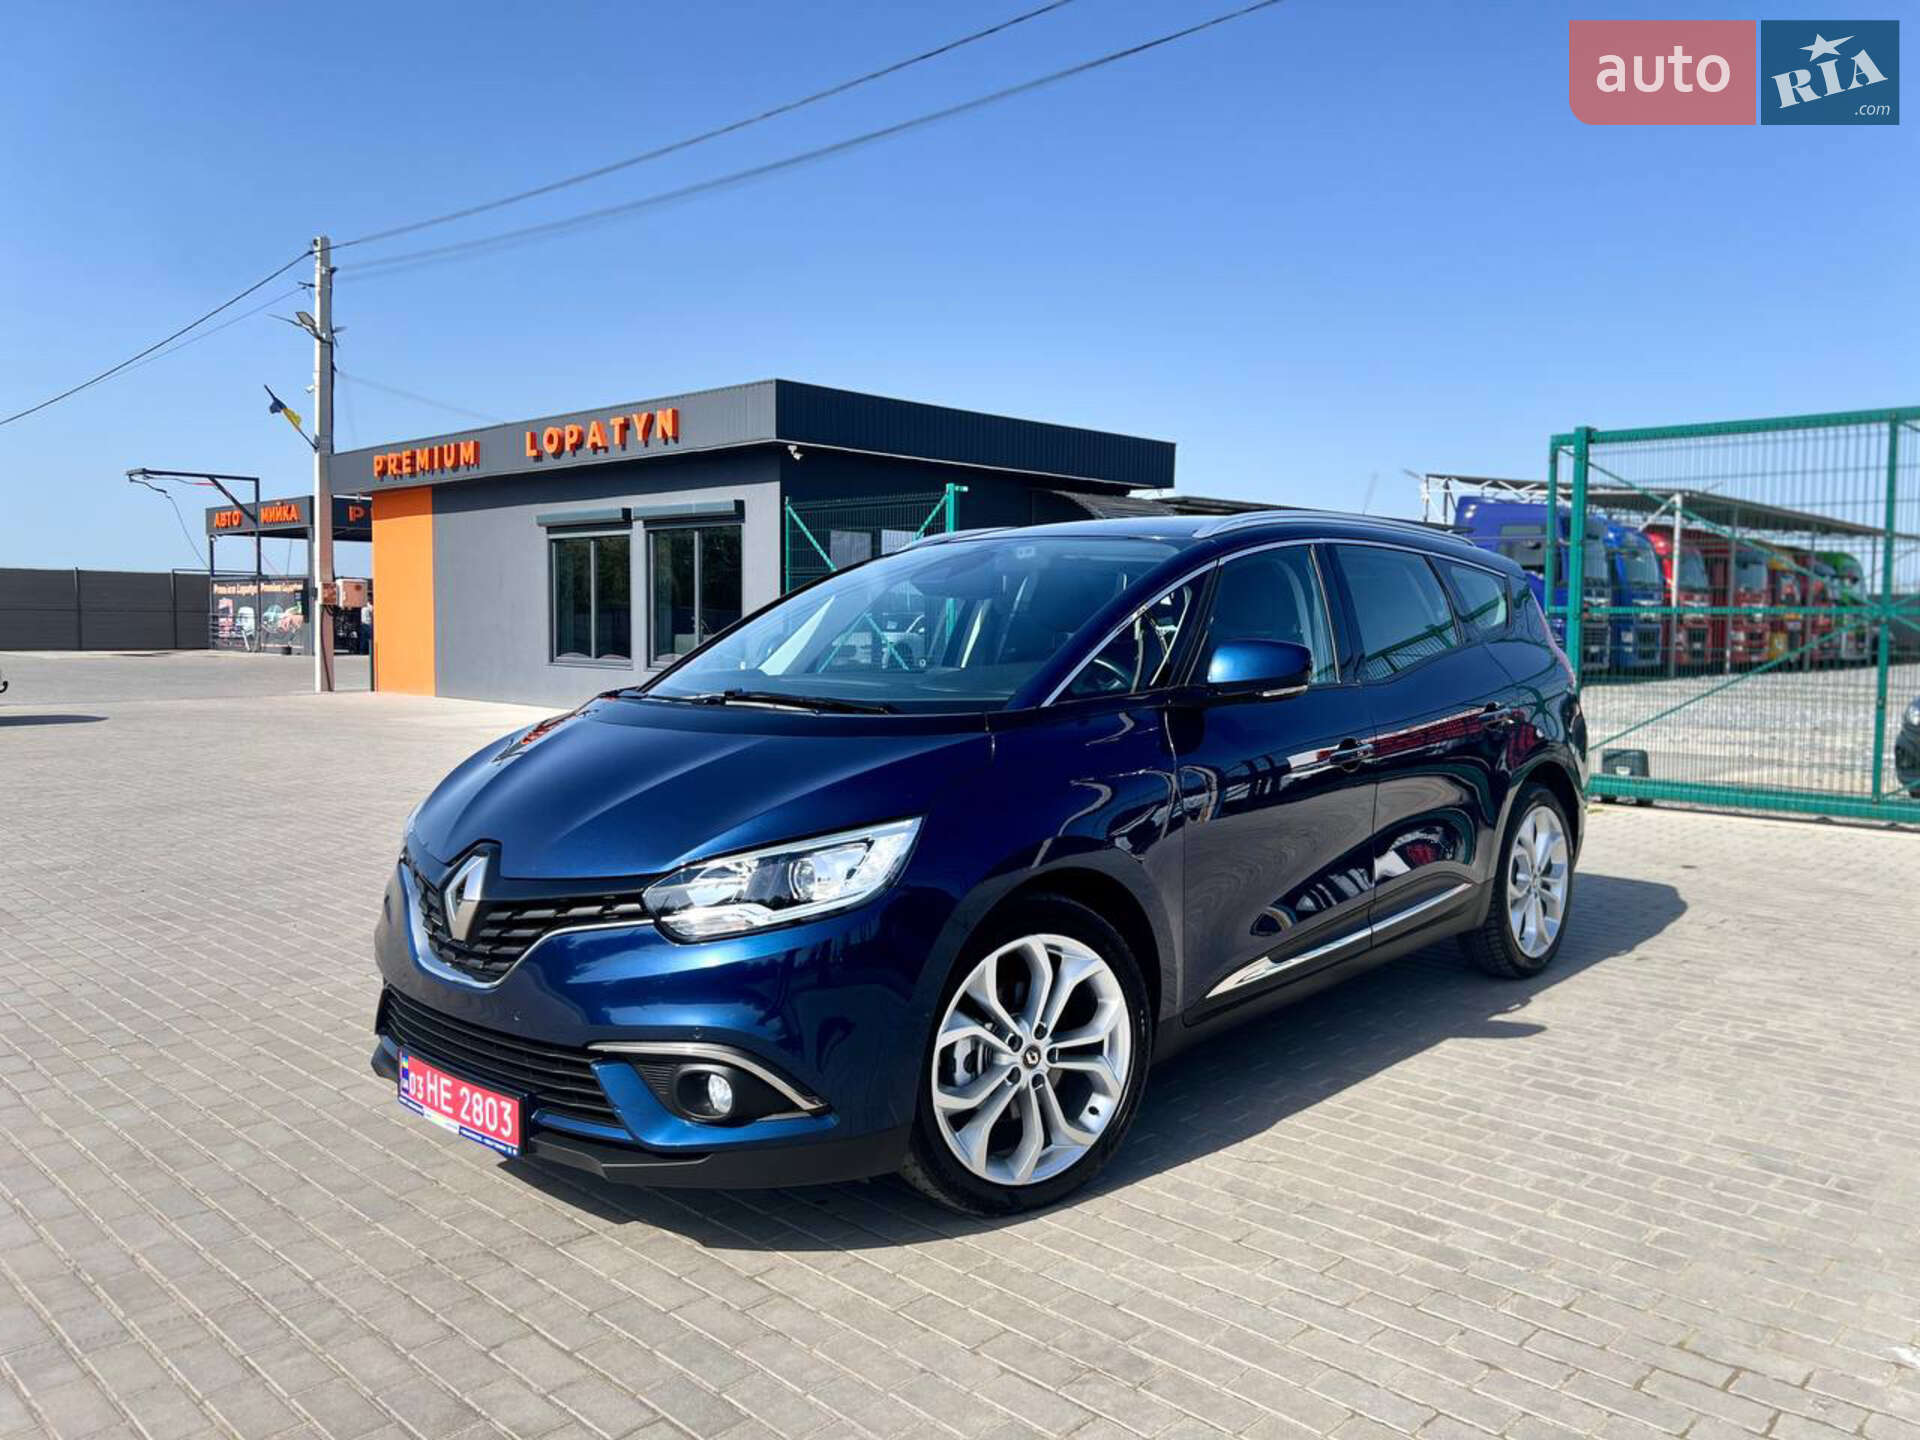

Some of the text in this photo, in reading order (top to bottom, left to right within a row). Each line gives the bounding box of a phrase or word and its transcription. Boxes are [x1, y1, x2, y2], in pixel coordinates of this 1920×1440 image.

[373, 408, 679, 479] PREMIUM LOPATYN
[459, 1086, 513, 1138] 2803
